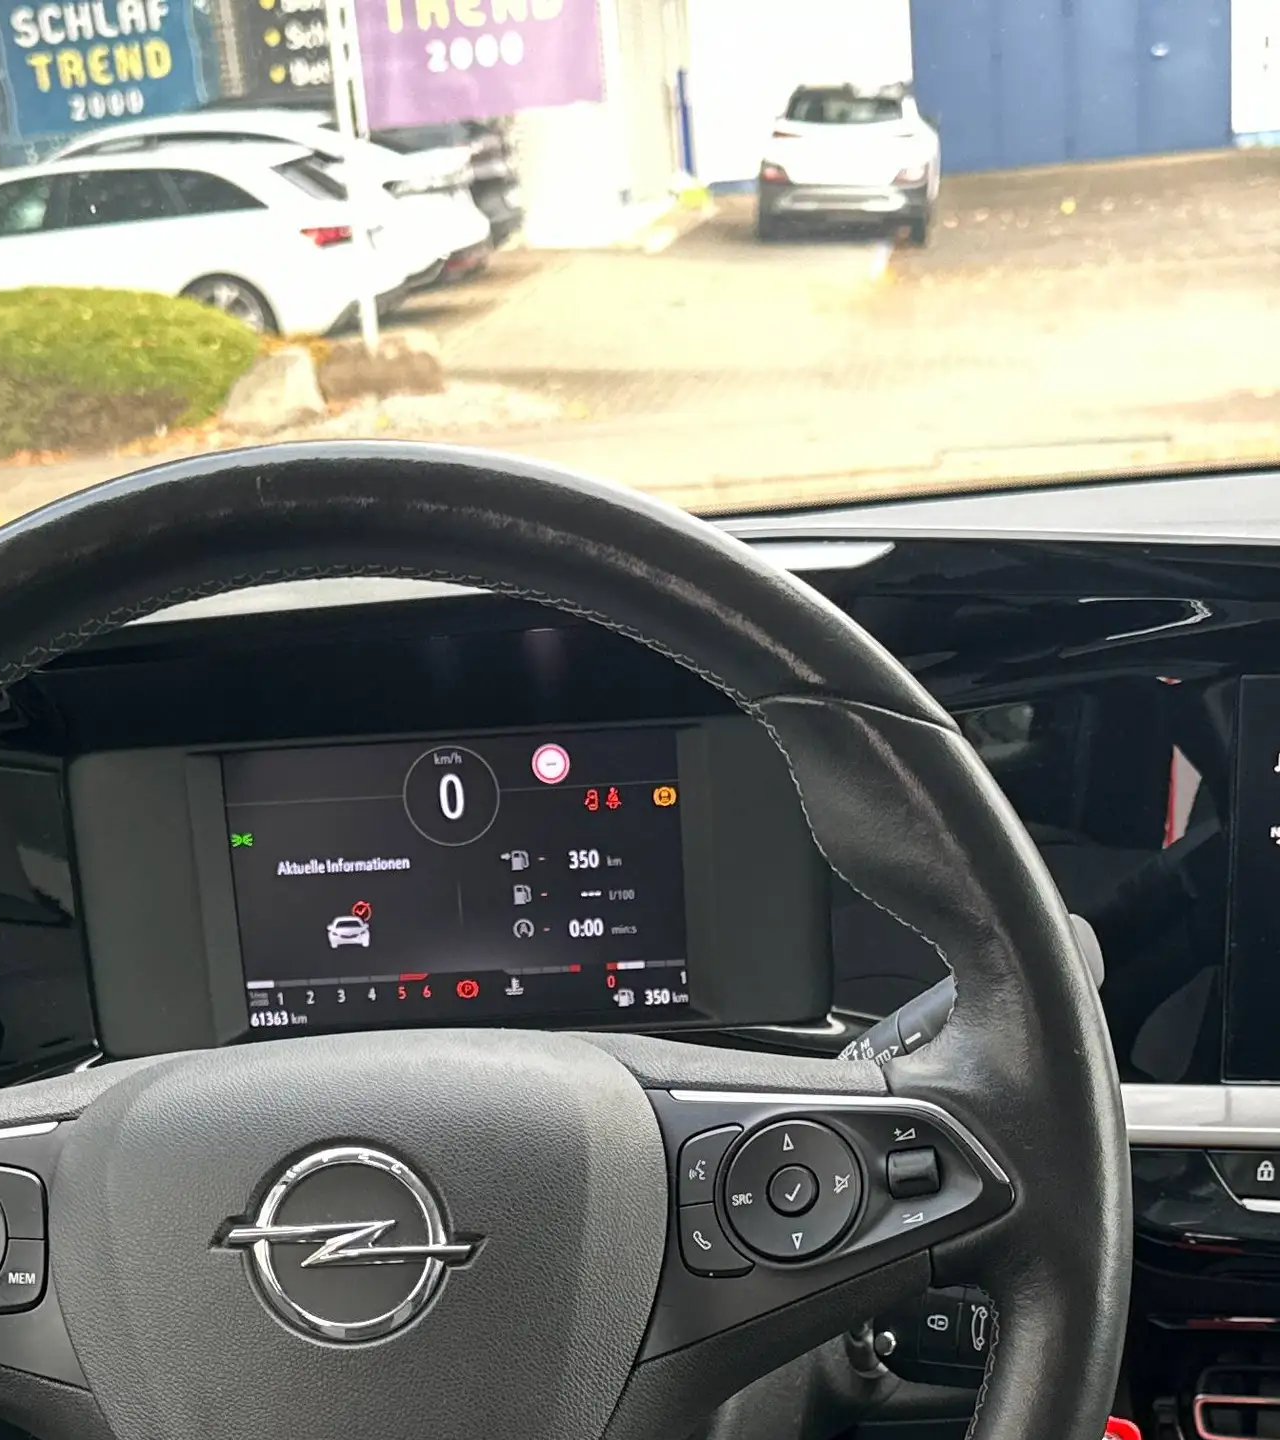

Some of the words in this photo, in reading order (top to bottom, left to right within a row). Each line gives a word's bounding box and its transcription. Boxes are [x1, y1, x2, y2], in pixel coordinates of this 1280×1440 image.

[10, 0, 169, 48] SCHLAF
[426, 32, 524, 73] 2000
[25, 37, 173, 93] TREND
[69, 89, 144, 122] 2000
[433, 753, 462, 765] km/h
[439, 773, 464, 819] 0
[277, 861, 325, 875] Aktuelle
[327, 858, 410, 873] Informationen
[569, 850, 599, 869] 350
[569, 918, 604, 938] 0:00
[277, 992, 284, 1005] 1
[306, 991, 315, 1005] 2
[337, 989, 346, 1003] 3
[368, 987, 376, 1001] 4
[398, 986, 407, 999] 5
[423, 985, 432, 998] 6
[644, 989, 670, 1005] 350
[250, 1011, 289, 1027] 61363
[291, 1014, 308, 1024] km
[731, 1193, 753, 1206] SRC
[8, 1272, 36, 1284] MEM
